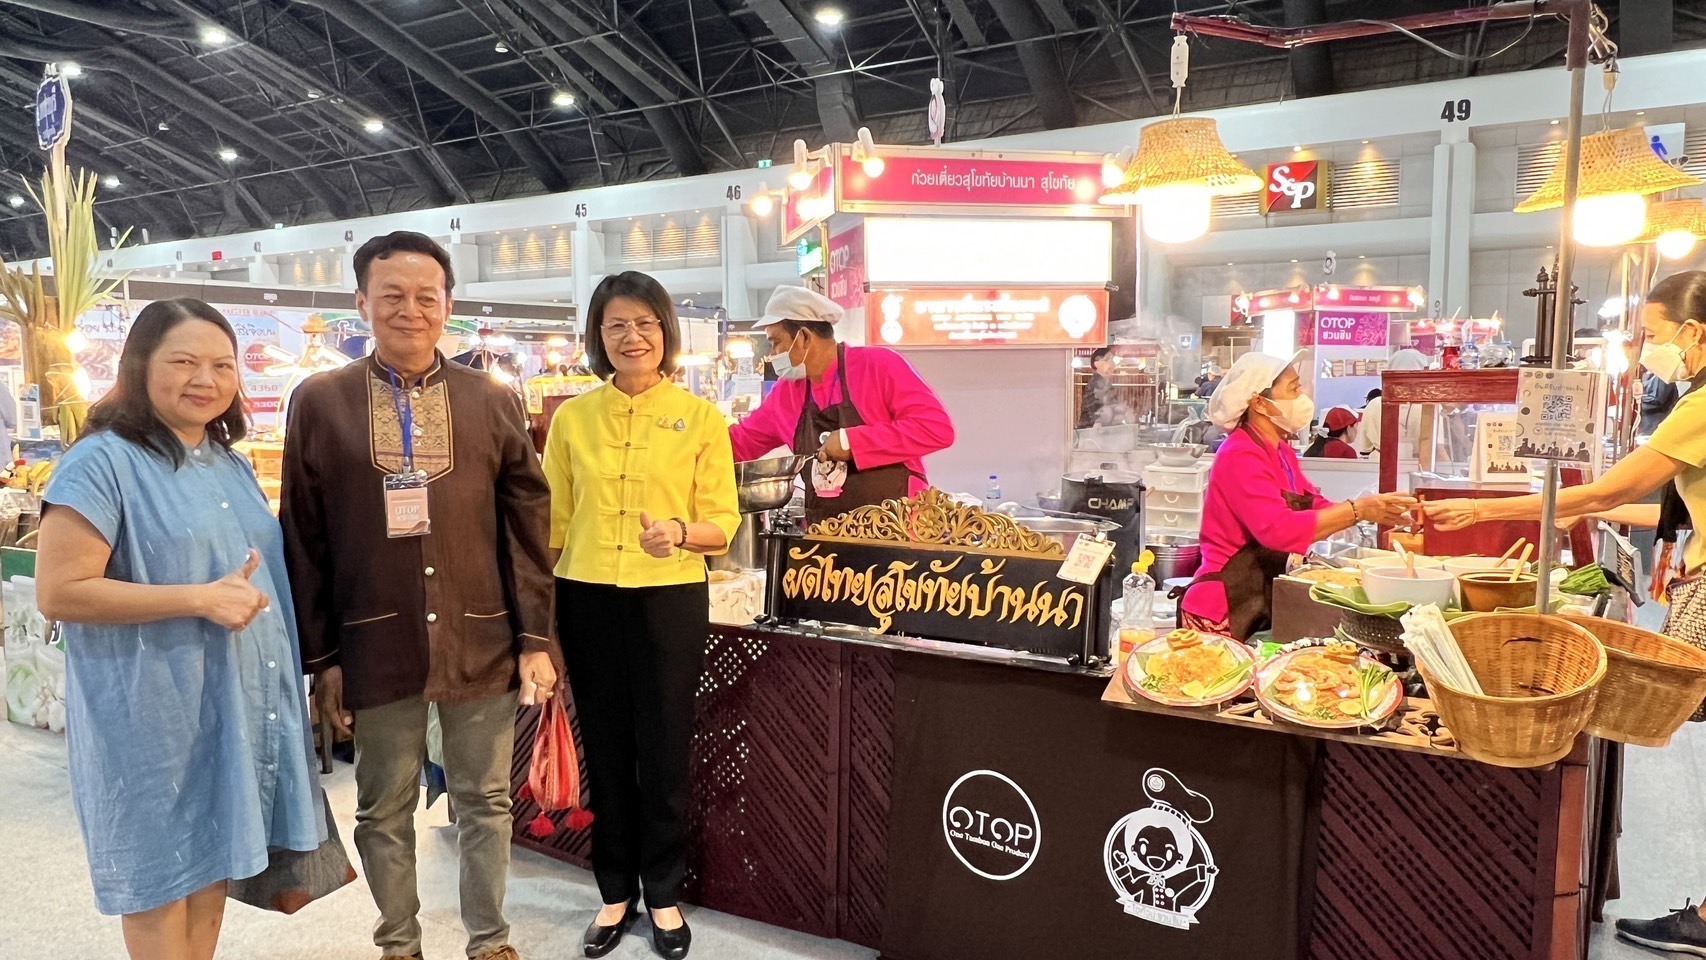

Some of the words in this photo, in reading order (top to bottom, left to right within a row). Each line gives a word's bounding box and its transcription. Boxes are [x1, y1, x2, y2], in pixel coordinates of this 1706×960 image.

[1441, 99, 1472, 122] 49
[726, 185, 741, 201] 46
[1041, 171, 1076, 194] สุโขทัย
[1269, 165, 1315, 209] S&P
[575, 203, 588, 218] 45
[450, 218, 461, 231] 44
[829, 245, 850, 275] OTOP
[1320, 317, 1356, 329] OTOP
[1087, 497, 1134, 510] CHAMP
[782, 543, 1085, 635] ผัดไทยสุโขทัยบ้านนา
[949, 806, 1033, 846] OTOP
[949, 829, 964, 839] One
[991, 840, 1004, 852] One
[1004, 845, 1030, 860] Product
